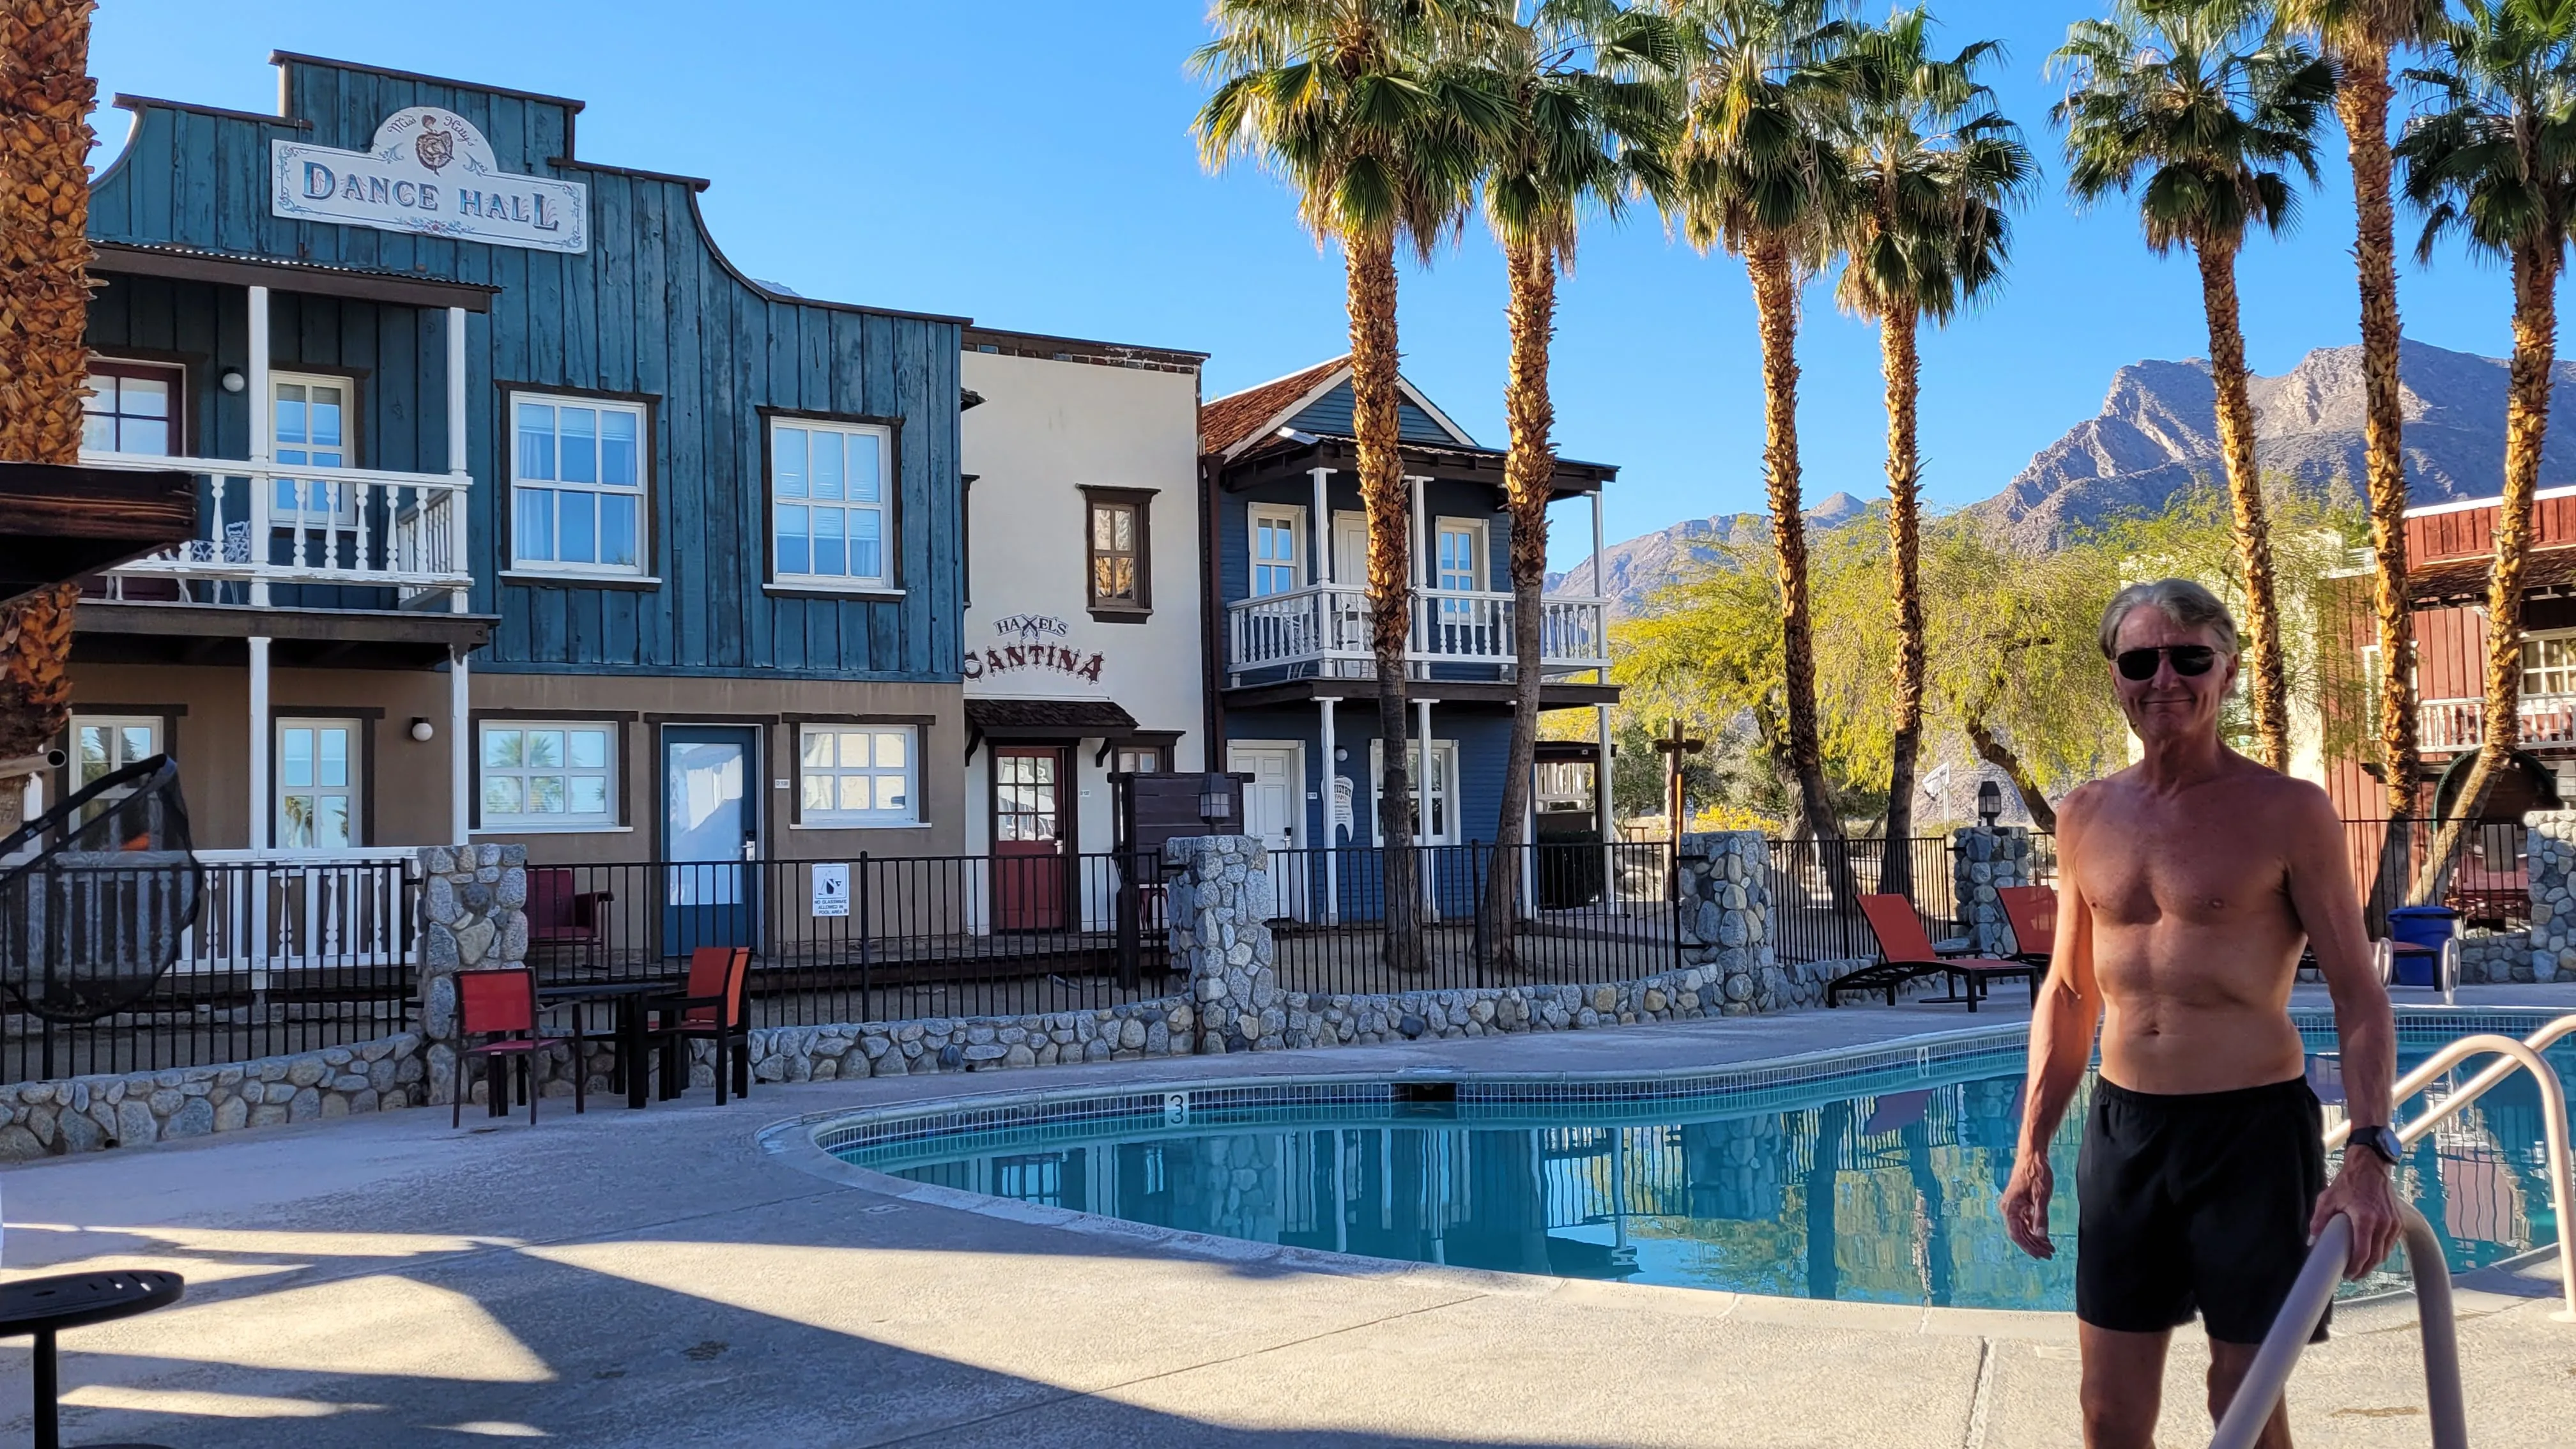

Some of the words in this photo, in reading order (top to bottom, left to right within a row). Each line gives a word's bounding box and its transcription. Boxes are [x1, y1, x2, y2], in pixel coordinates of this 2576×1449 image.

[387, 116, 417, 133] Miss
[302, 160, 440, 211] DANCE
[458, 188, 559, 231] HALL
[963, 641, 1105, 684] CANTINA
[1170, 1094, 1184, 1123] 3
